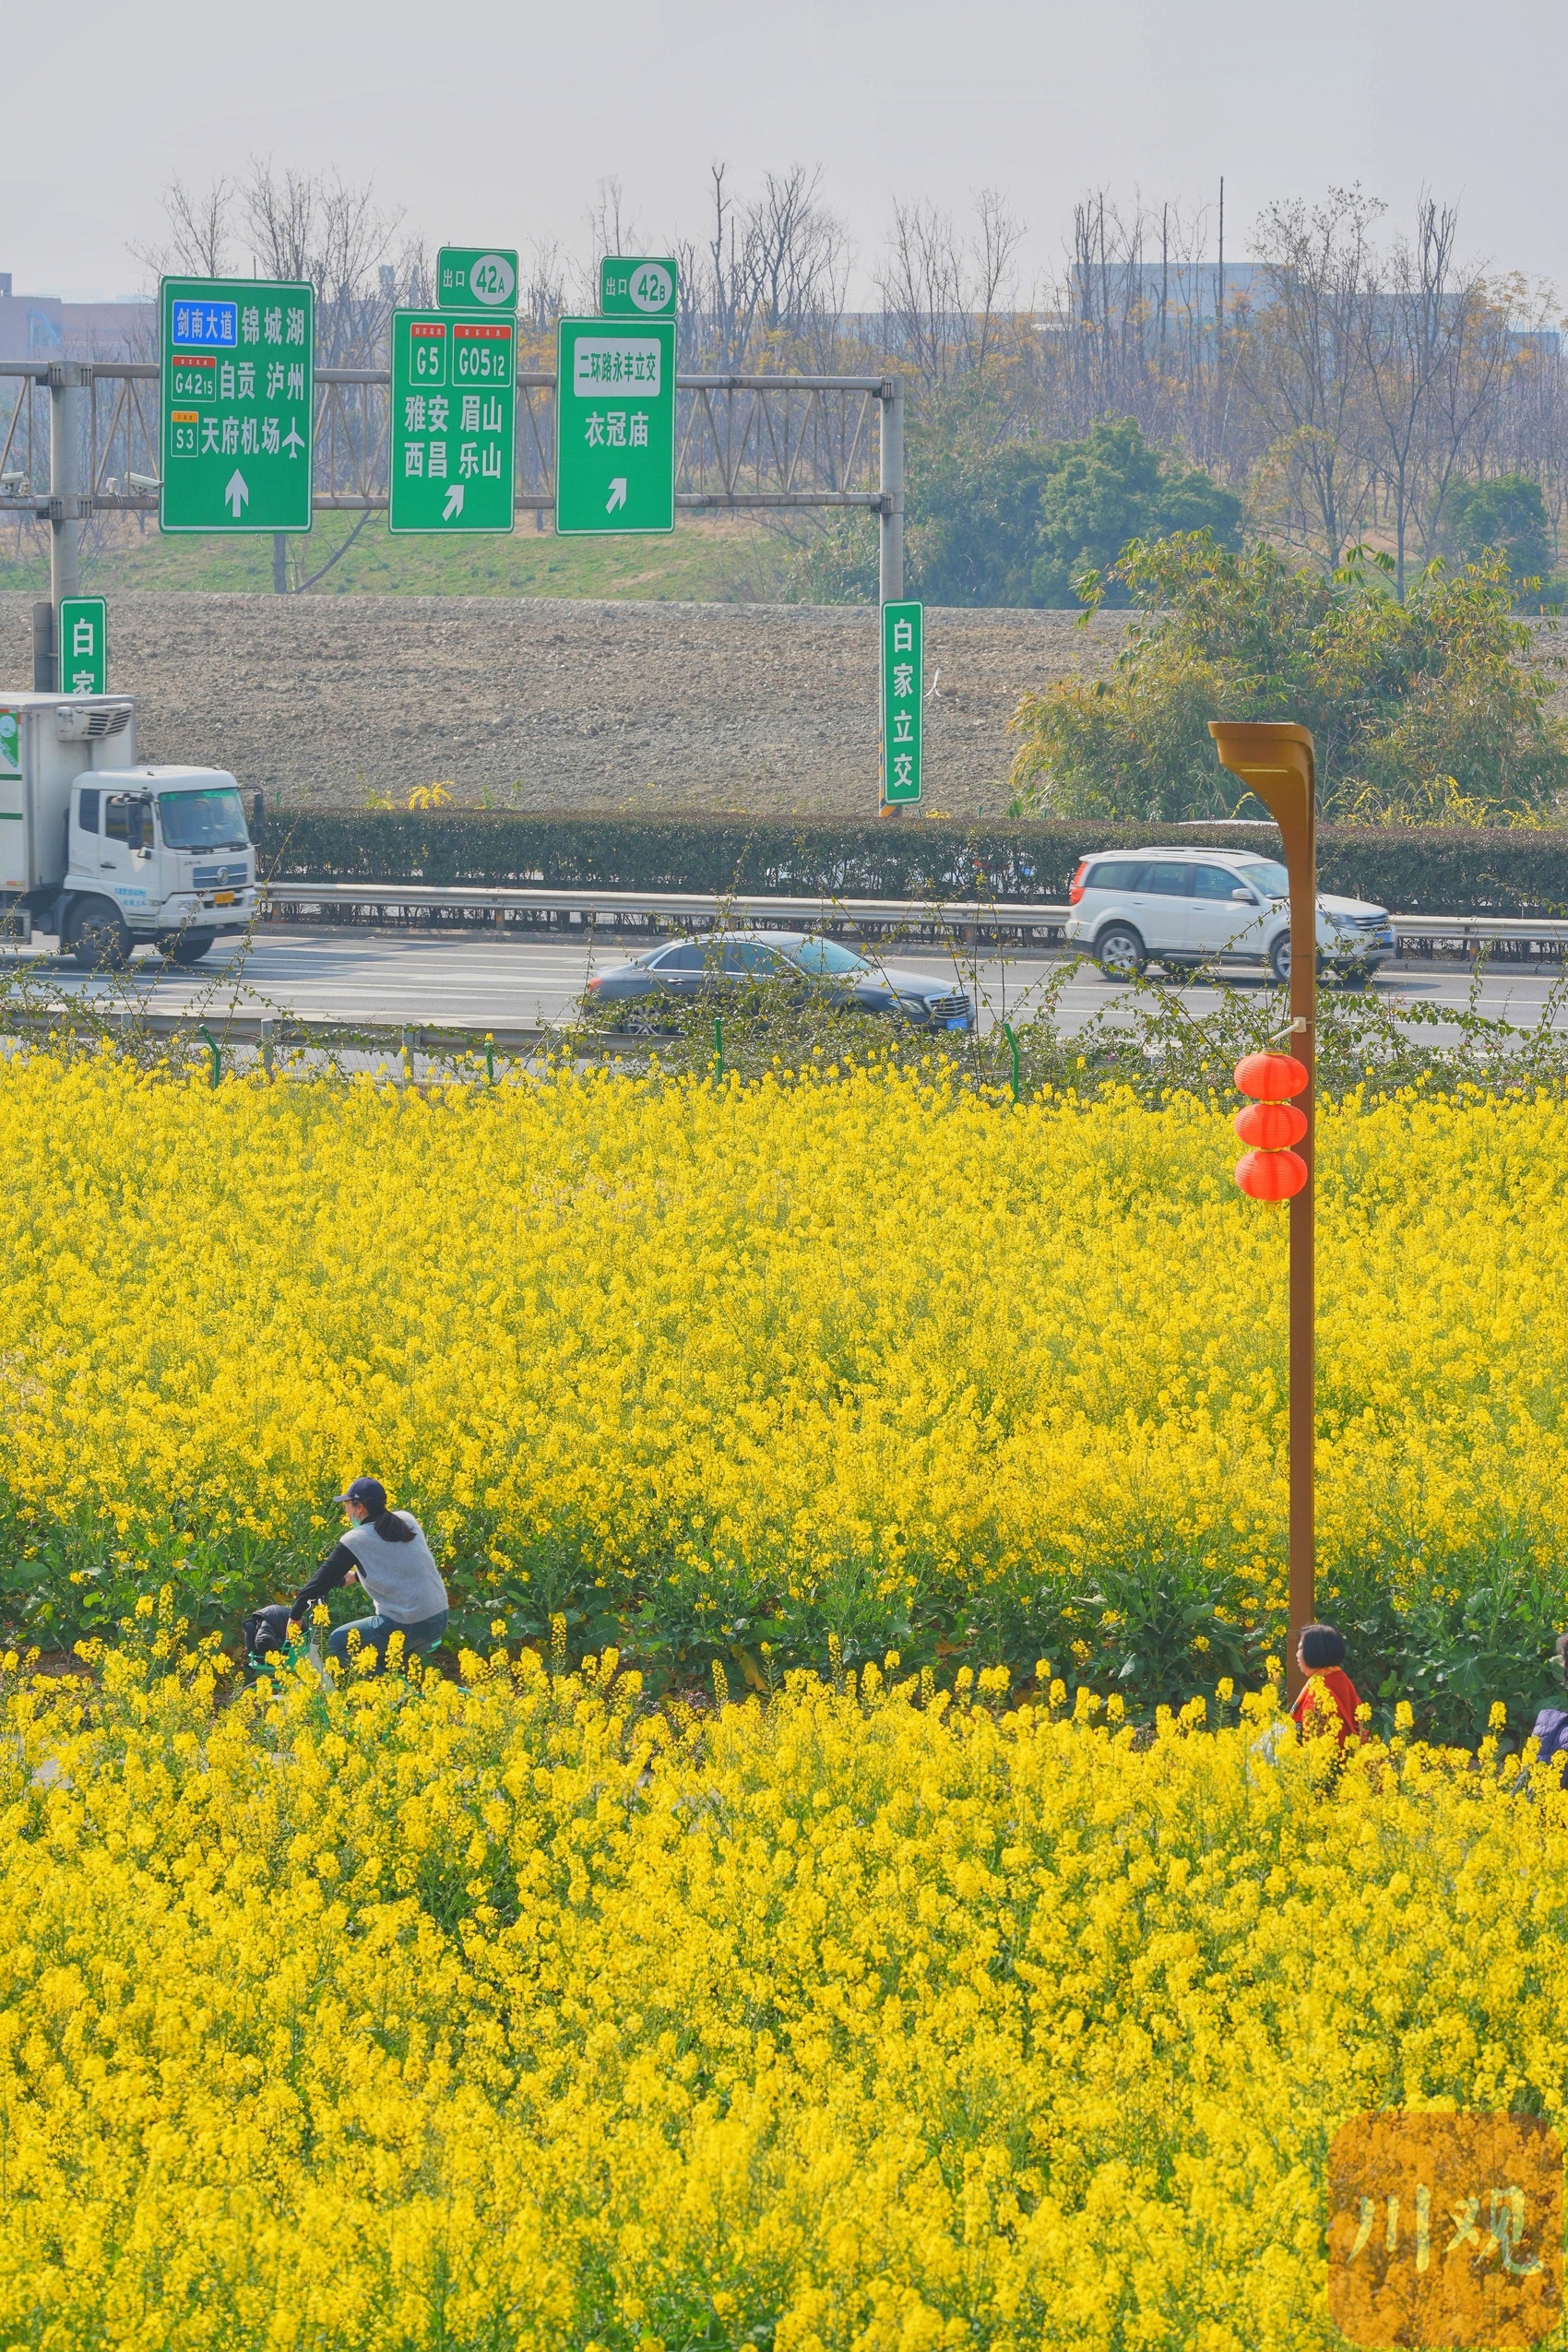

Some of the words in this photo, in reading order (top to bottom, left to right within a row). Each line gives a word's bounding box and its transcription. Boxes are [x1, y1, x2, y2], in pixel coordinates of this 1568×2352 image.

[443, 268, 465, 288] 出口
[476, 265, 505, 293] 42A
[606, 277, 627, 297] 出口
[637, 274, 666, 302] 42B
[177, 307, 233, 340] 剑南大道
[242, 305, 304, 346] 锦城湖
[417, 347, 439, 375] G5
[459, 348, 505, 376] G0512
[578, 351, 656, 383] 二环路永丰立交
[175, 373, 213, 395] G4215
[220, 360, 255, 400] 自贡
[266, 362, 304, 400] 泸州
[404, 395, 449, 433] 雅安
[459, 395, 503, 433] 眉山
[584, 410, 649, 448] 衣冠庙
[176, 428, 194, 449] S3
[200, 415, 280, 456] 天府机场
[404, 441, 448, 479] 西昌
[458, 441, 502, 480] 乐山
[893, 618, 914, 788] 白家立交
